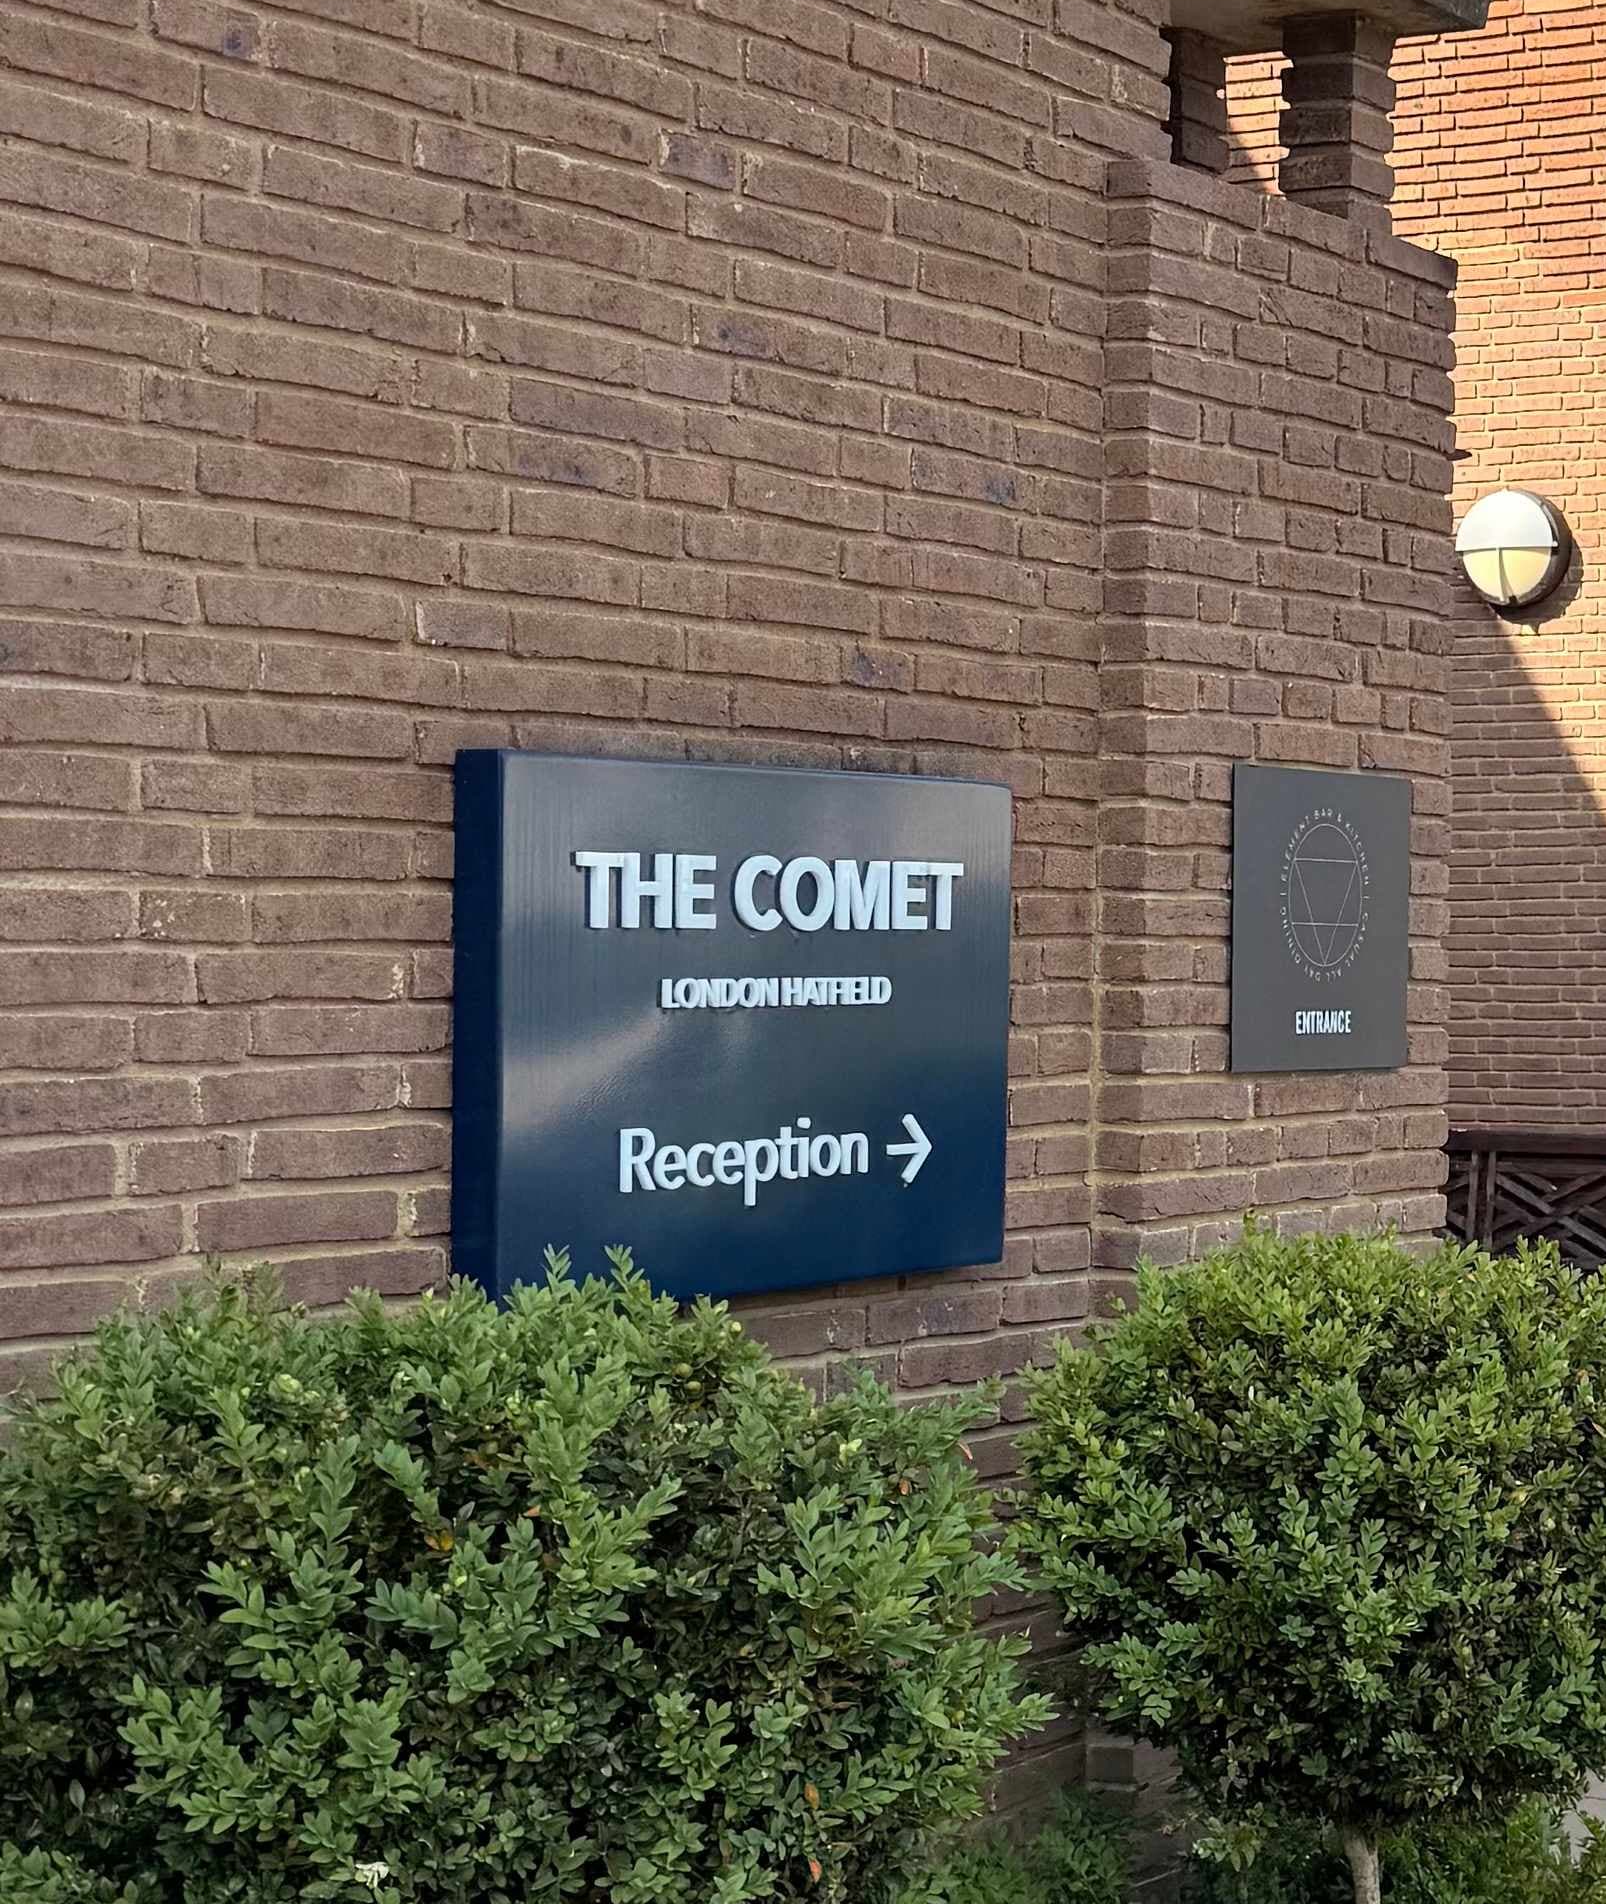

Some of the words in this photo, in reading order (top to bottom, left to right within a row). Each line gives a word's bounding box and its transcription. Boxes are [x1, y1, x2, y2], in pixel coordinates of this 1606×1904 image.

[1313, 807, 1333, 820] BAR
[1344, 822, 1369, 886] KITCHEN
[575, 850, 717, 930] THE
[733, 854, 964, 932] COMET
[660, 977, 779, 1009] LONDON
[781, 976, 893, 1006] HATFIELD
[1295, 1010, 1352, 1035] ENTRANCE
[619, 1116, 869, 1207] Reception
